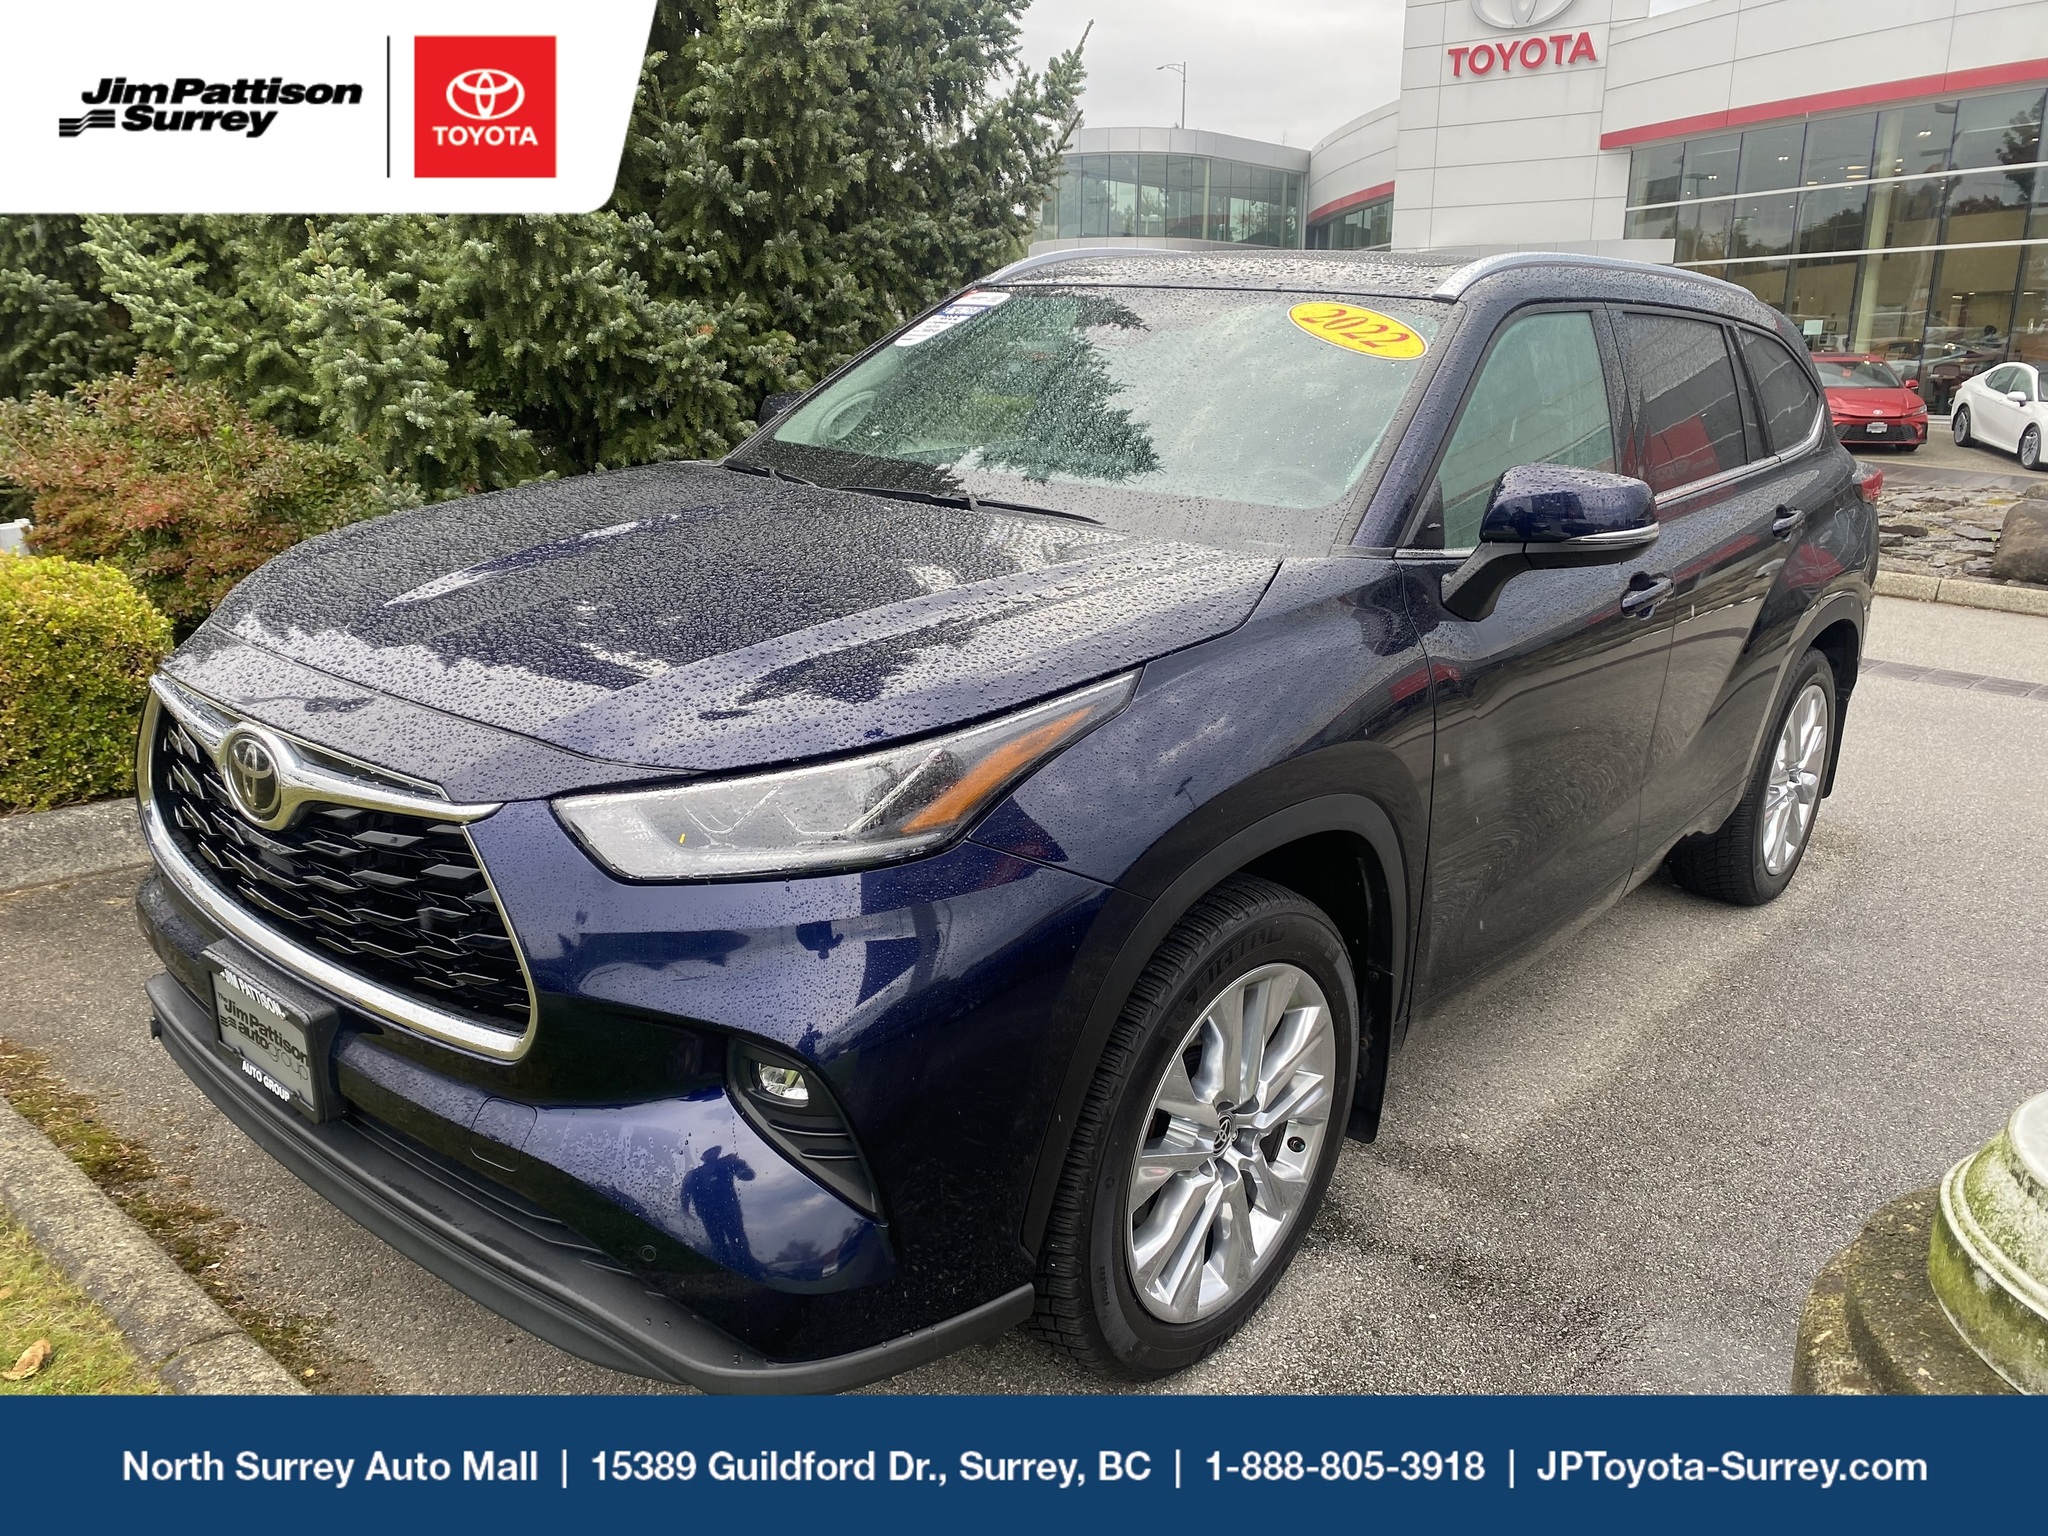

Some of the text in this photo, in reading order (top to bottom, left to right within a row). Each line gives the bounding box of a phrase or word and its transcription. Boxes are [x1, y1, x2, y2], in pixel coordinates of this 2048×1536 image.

[1448, 32, 1596, 77] TOYOTA
[1299, 309, 1410, 348] 2022
[242, 1060, 290, 1102] AUTO GROUP
